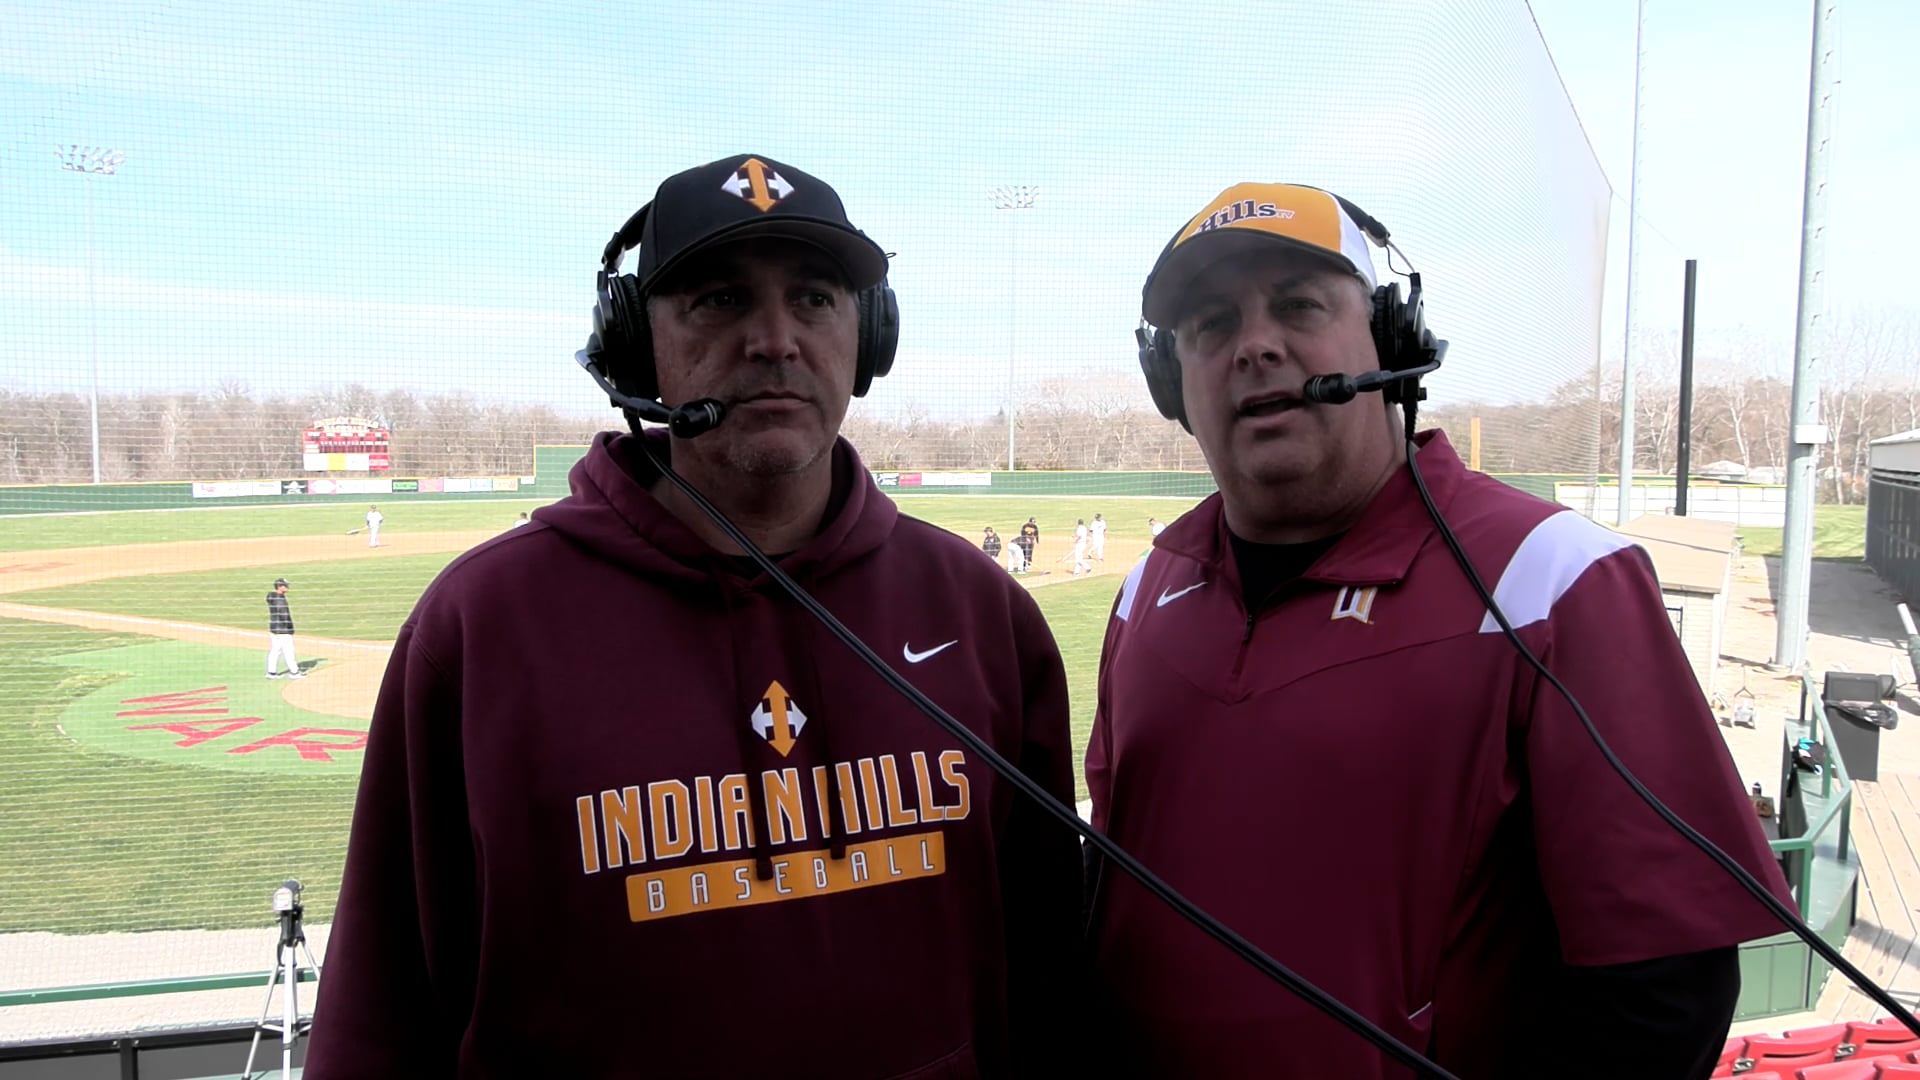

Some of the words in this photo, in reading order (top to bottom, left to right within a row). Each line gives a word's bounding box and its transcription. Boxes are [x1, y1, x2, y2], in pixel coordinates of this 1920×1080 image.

[576, 767, 808, 874] INDIAN
[811, 750, 971, 839] HILLS
[645, 839, 936, 914] BASEBALL
